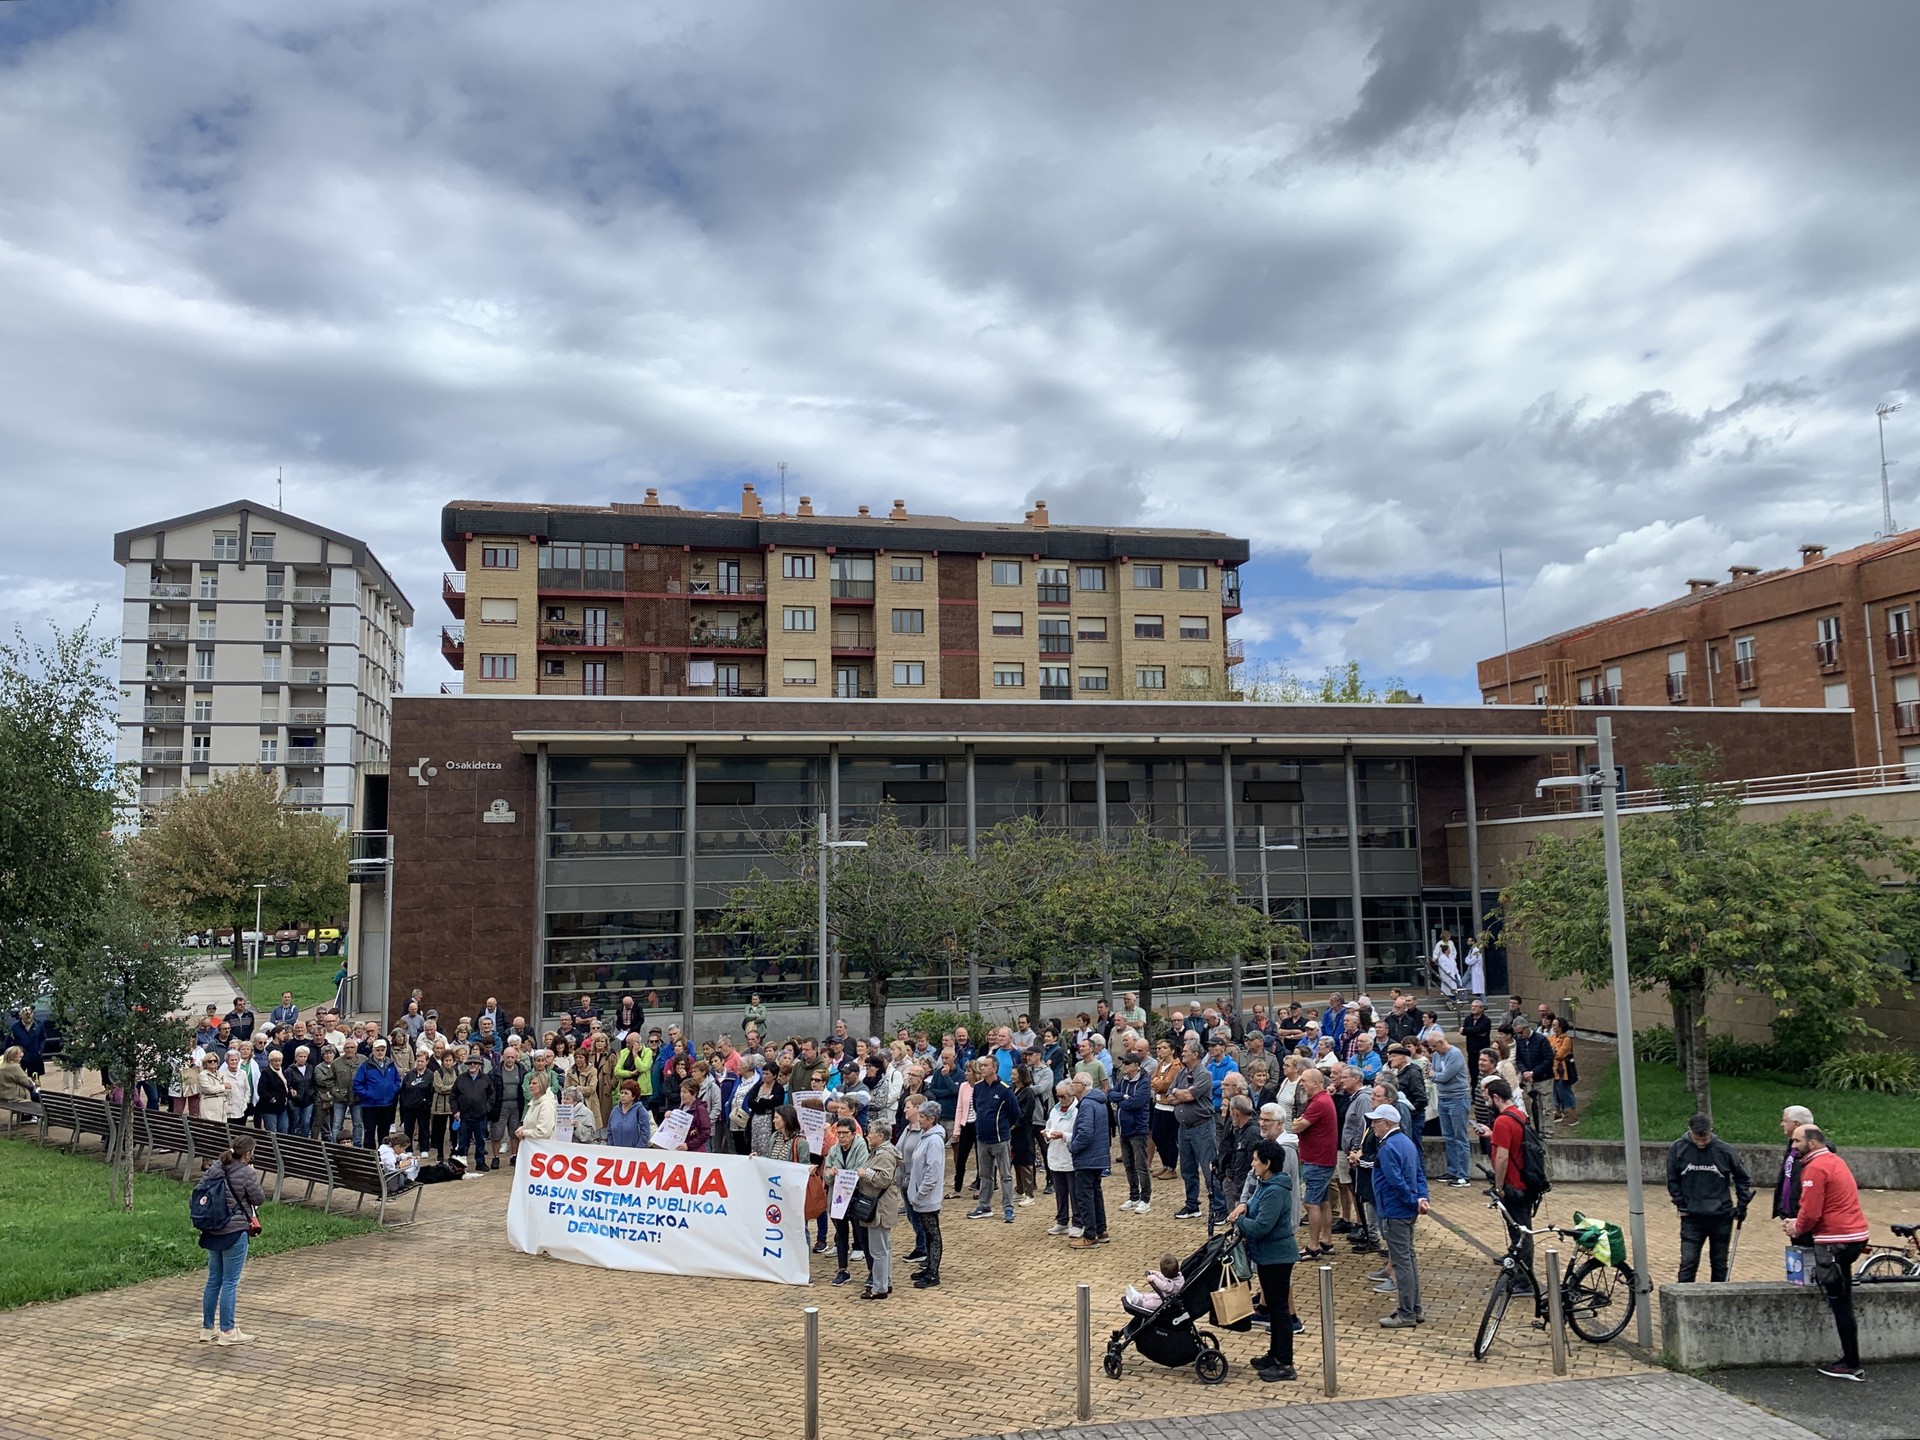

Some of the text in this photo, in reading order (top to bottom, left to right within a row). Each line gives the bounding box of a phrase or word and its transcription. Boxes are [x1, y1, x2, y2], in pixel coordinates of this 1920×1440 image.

[445, 760, 502, 770] Osakidetza
[529, 1152, 729, 1198] SOS ZUMAIA
[528, 1183, 728, 1216] OSASUN SISTEMA PUBLIKOA
[548, 1201, 689, 1229] ETA KALITATEZKOA
[567, 1220, 662, 1243] DENONTZAT!
